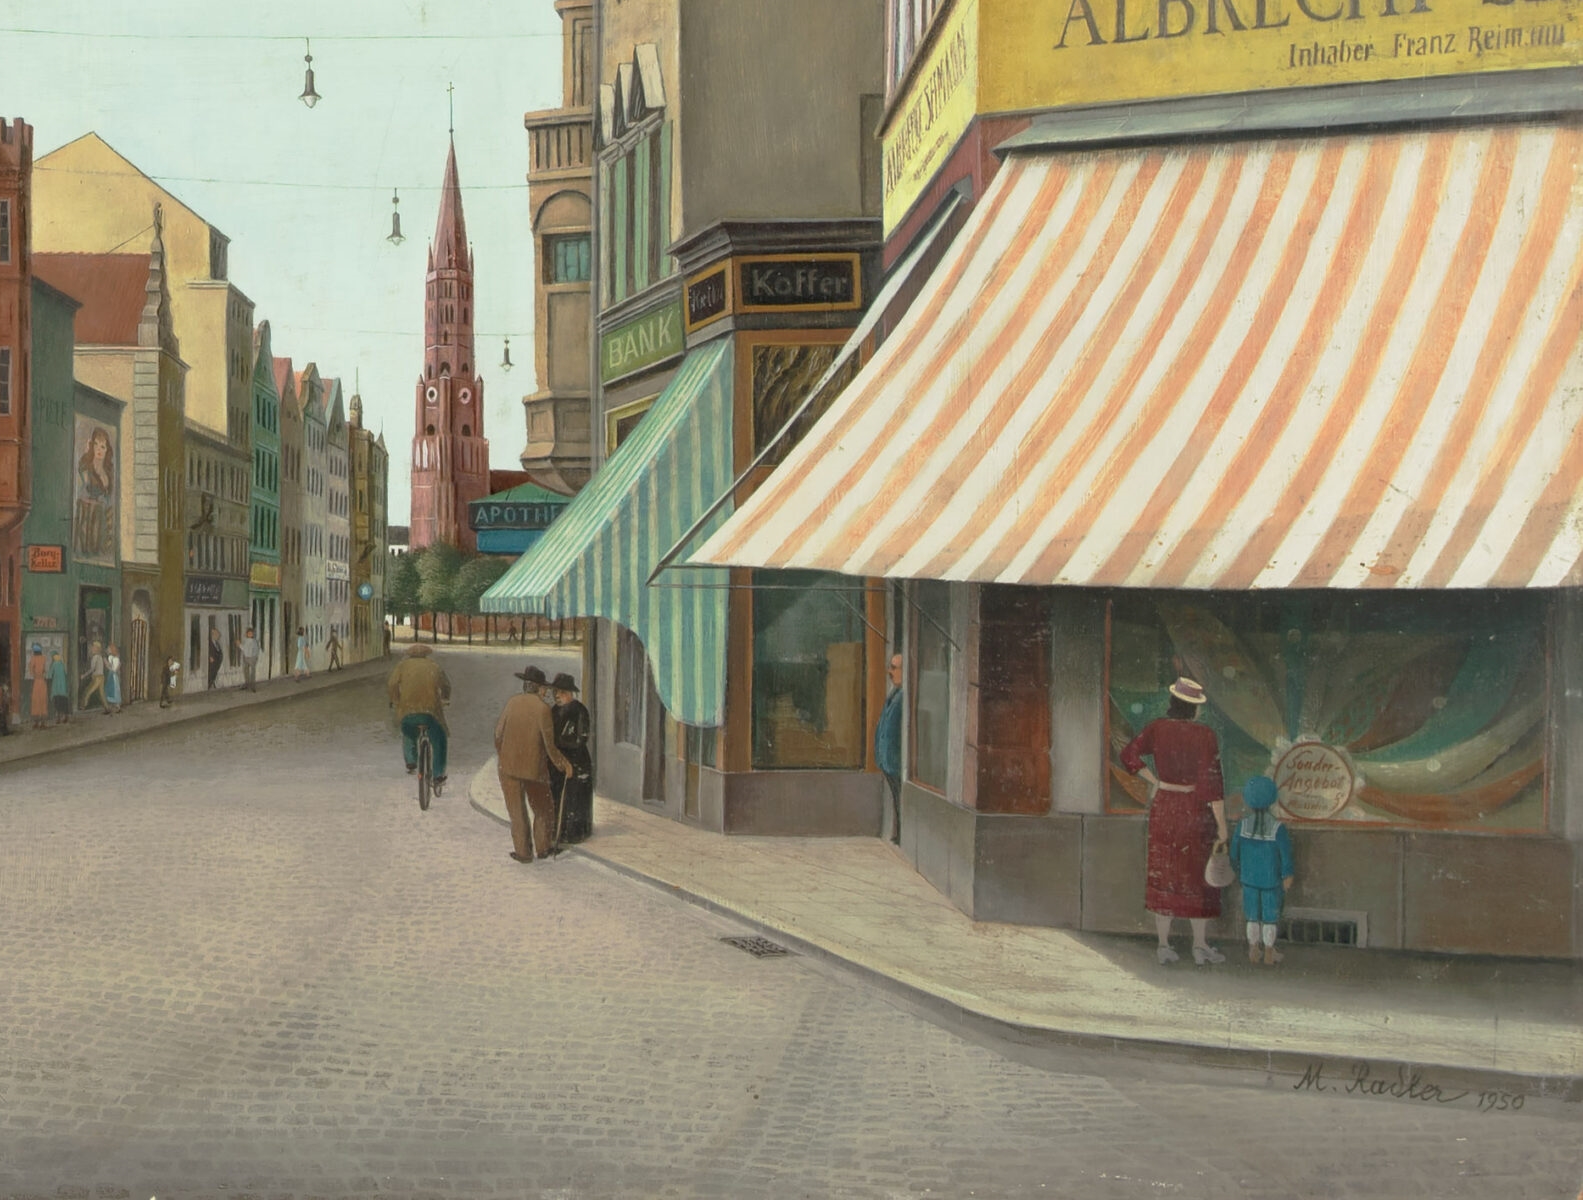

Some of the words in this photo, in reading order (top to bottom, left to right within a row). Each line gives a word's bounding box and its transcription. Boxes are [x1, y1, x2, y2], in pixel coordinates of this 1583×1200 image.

[1393, 32, 1456, 58] Franz
[752, 269, 849, 298] Koffer
[608, 309, 675, 369] BANK
[1476, 1091, 1525, 1113] 1950
